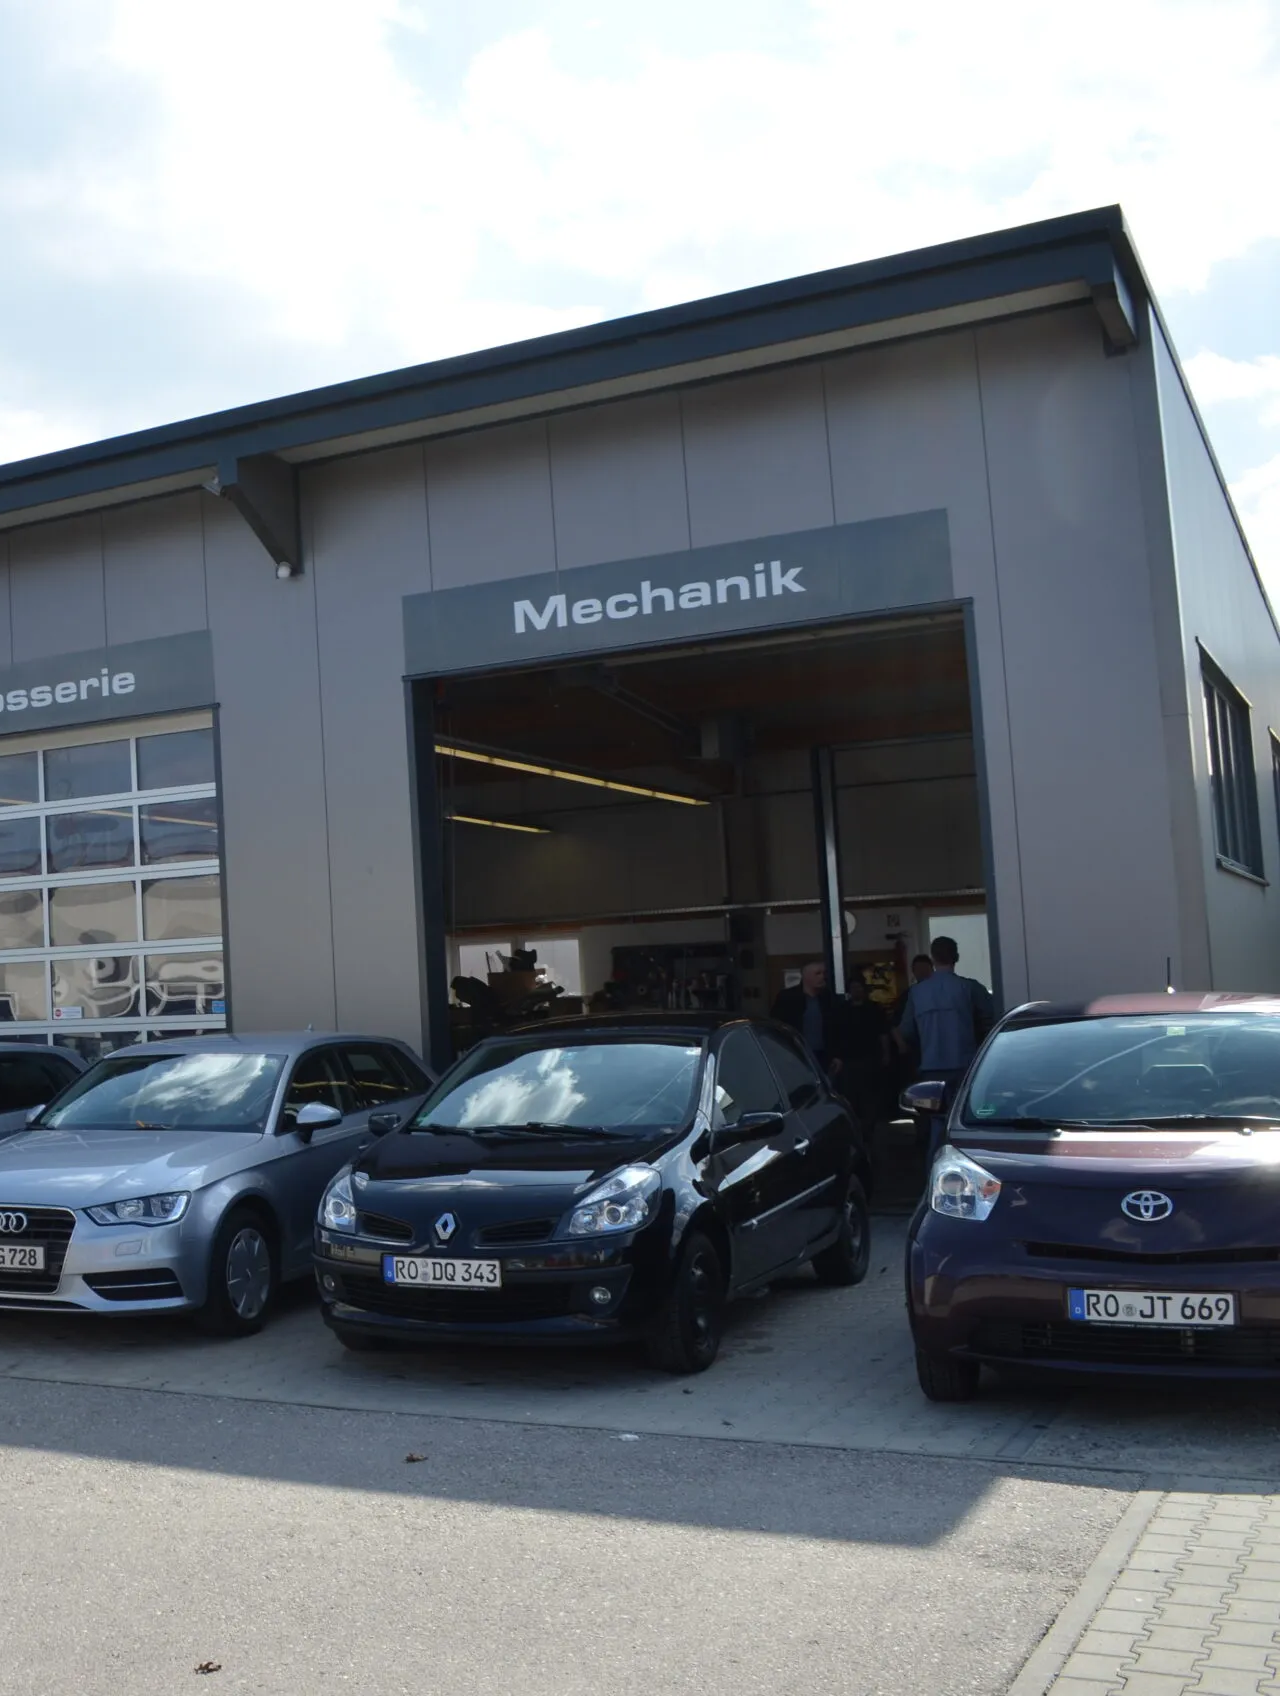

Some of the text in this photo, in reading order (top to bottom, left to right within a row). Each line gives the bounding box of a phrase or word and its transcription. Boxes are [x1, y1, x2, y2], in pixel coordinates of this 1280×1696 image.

[513, 559, 807, 634] Mechanik
[8, 1248, 37, 1266] 728
[395, 1260, 419, 1280] RO
[431, 1261, 456, 1282] DQ
[461, 1262, 497, 1283] 343
[1086, 1293, 1119, 1318] RO
[1139, 1295, 1173, 1319] JT
[1180, 1296, 1230, 1321] 669
